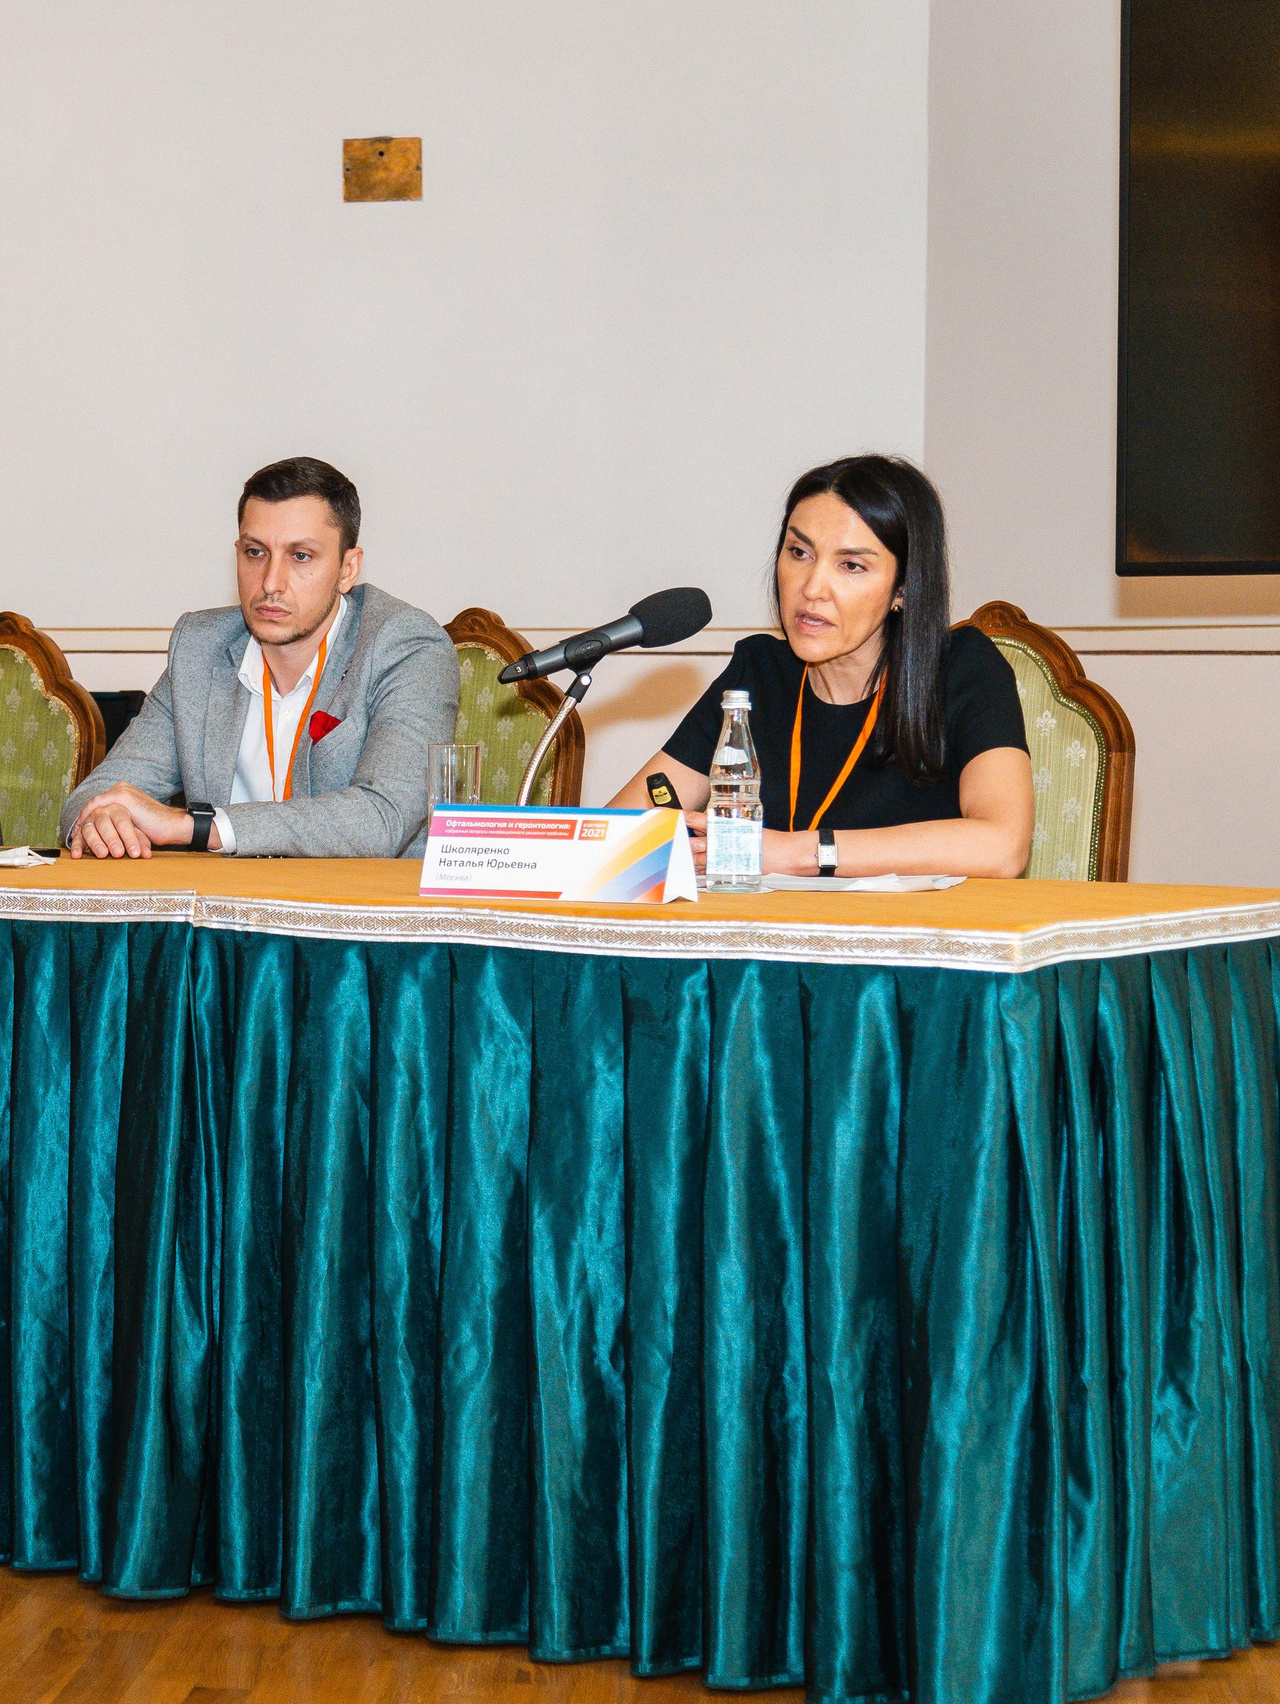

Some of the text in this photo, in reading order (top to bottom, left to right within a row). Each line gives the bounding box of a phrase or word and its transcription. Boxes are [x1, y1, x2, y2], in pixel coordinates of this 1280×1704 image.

[446, 820, 507, 829] Офтальмология
[514, 822, 571, 830] геронтология:
[581, 828, 605, 838] 2021
[441, 844, 510, 856] Школяренко
[439, 857, 537, 870] Наталья Юрьевна
[436, 873, 472, 882] (Москва)
